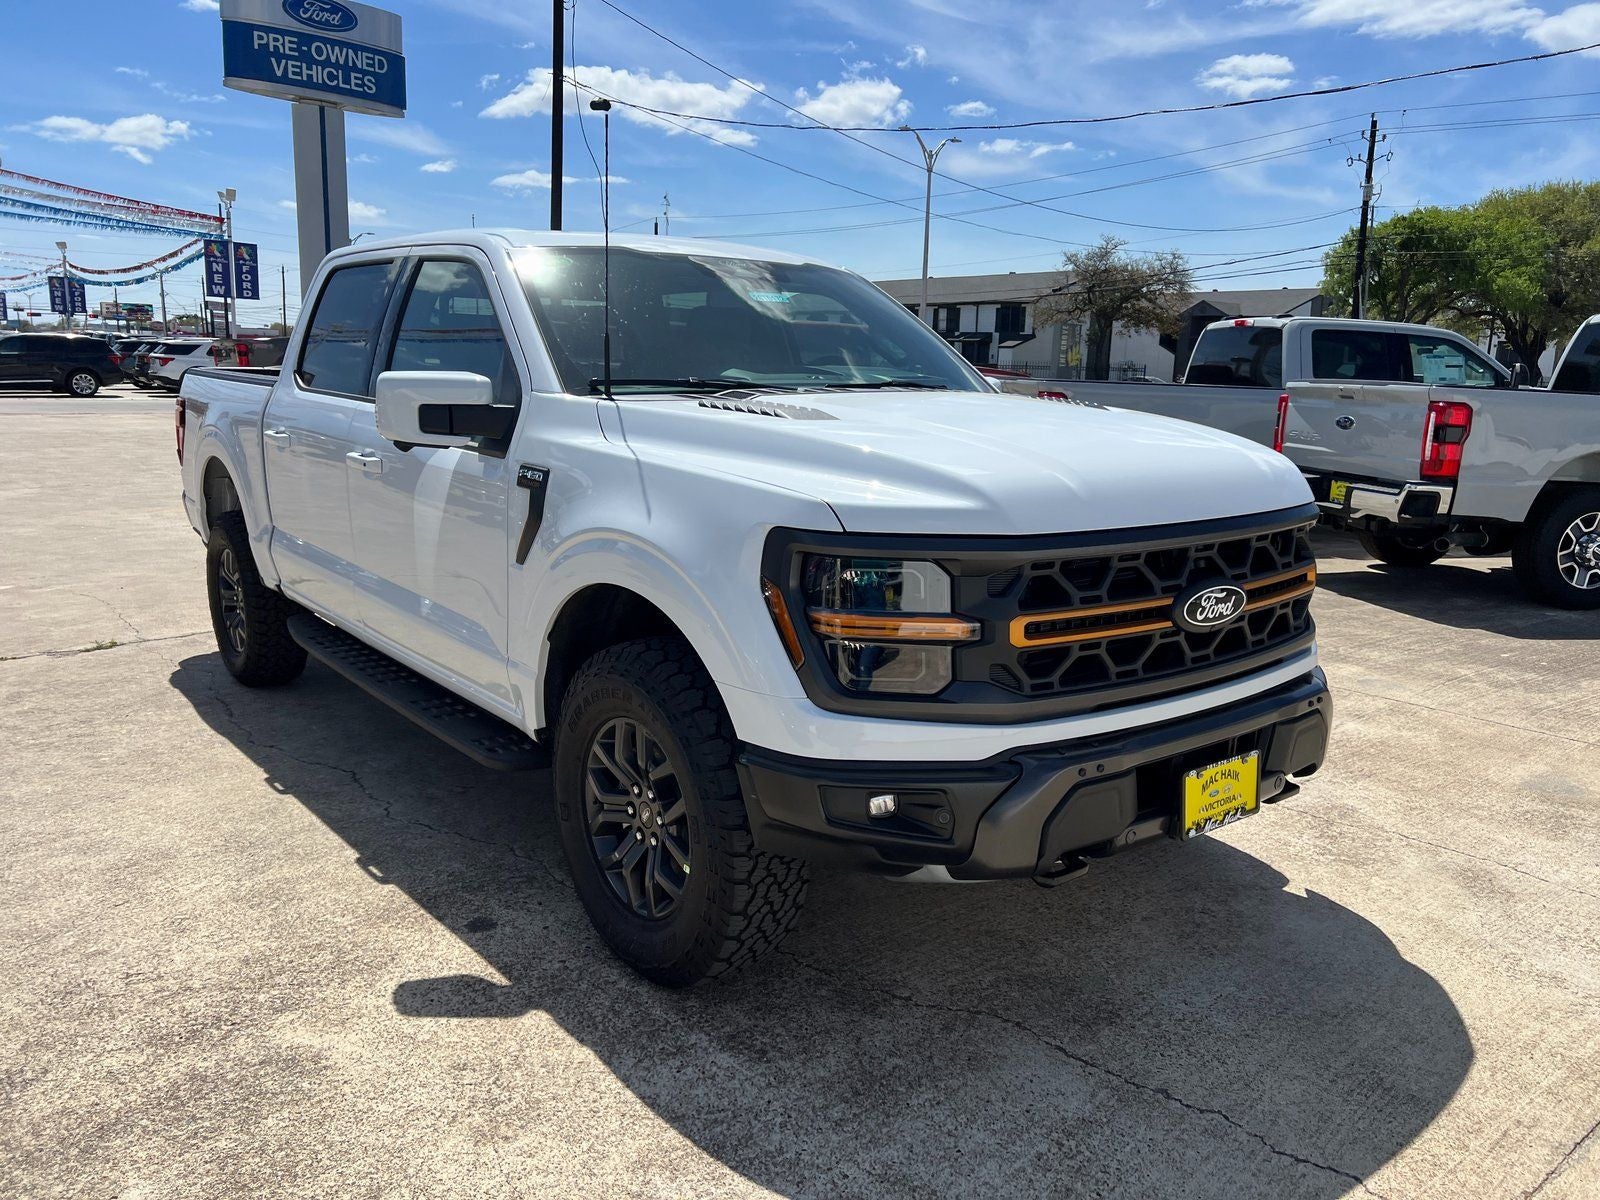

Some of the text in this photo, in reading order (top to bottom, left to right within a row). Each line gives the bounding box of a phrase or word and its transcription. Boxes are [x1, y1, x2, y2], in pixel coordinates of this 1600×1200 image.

[300, 0, 342, 25] Ford
[252, 30, 388, 74] PRE-OWNED
[270, 57, 376, 94] VEHICLES
[212, 262, 226, 295] NEW
[241, 265, 252, 297] FORD
[1196, 591, 1236, 621] Ford
[1202, 772, 1219, 795] MAC
[1220, 769, 1240, 782] HAIK
[1204, 794, 1237, 812] VICTORIA
